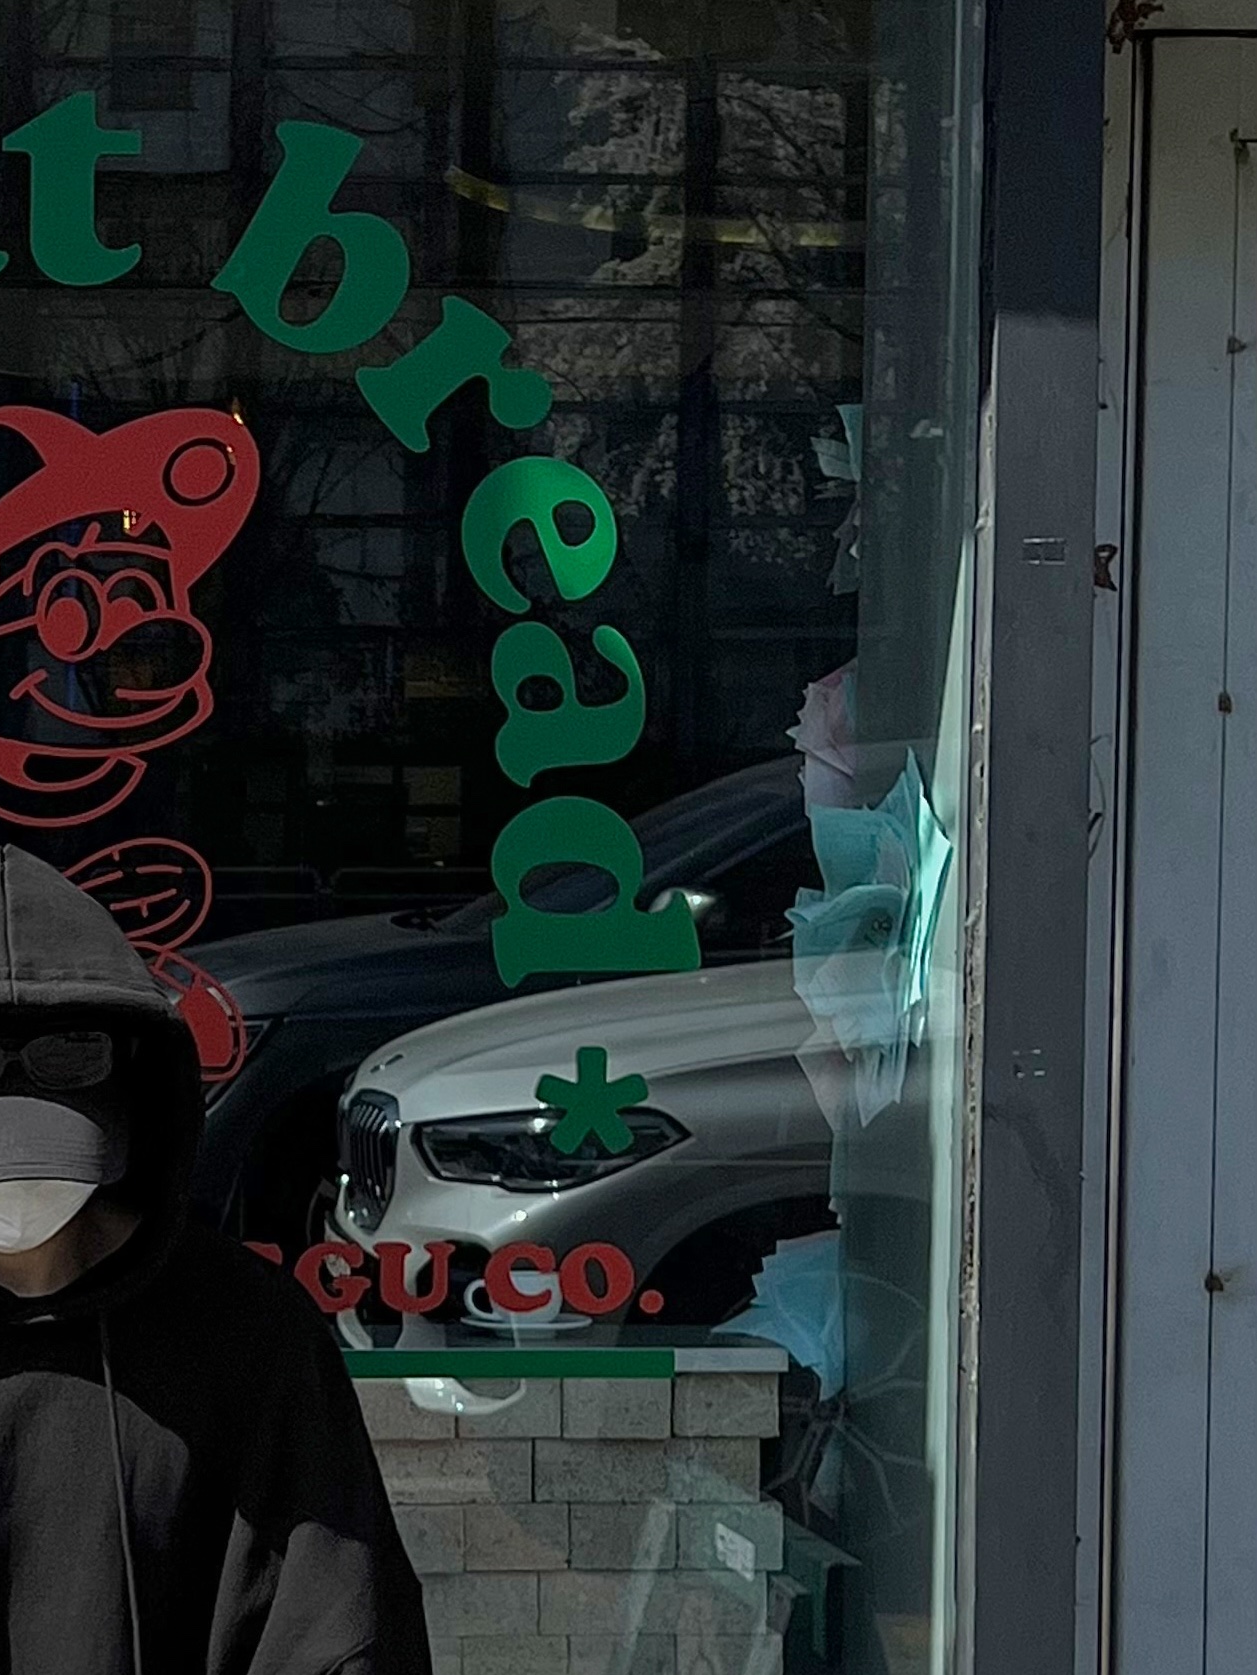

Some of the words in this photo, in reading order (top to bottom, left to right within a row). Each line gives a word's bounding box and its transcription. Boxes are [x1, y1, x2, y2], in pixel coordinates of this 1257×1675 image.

[210, 119, 705, 989] bread
[243, 1240, 452, 1313] GU
[484, 1241, 664, 1314] CO.
